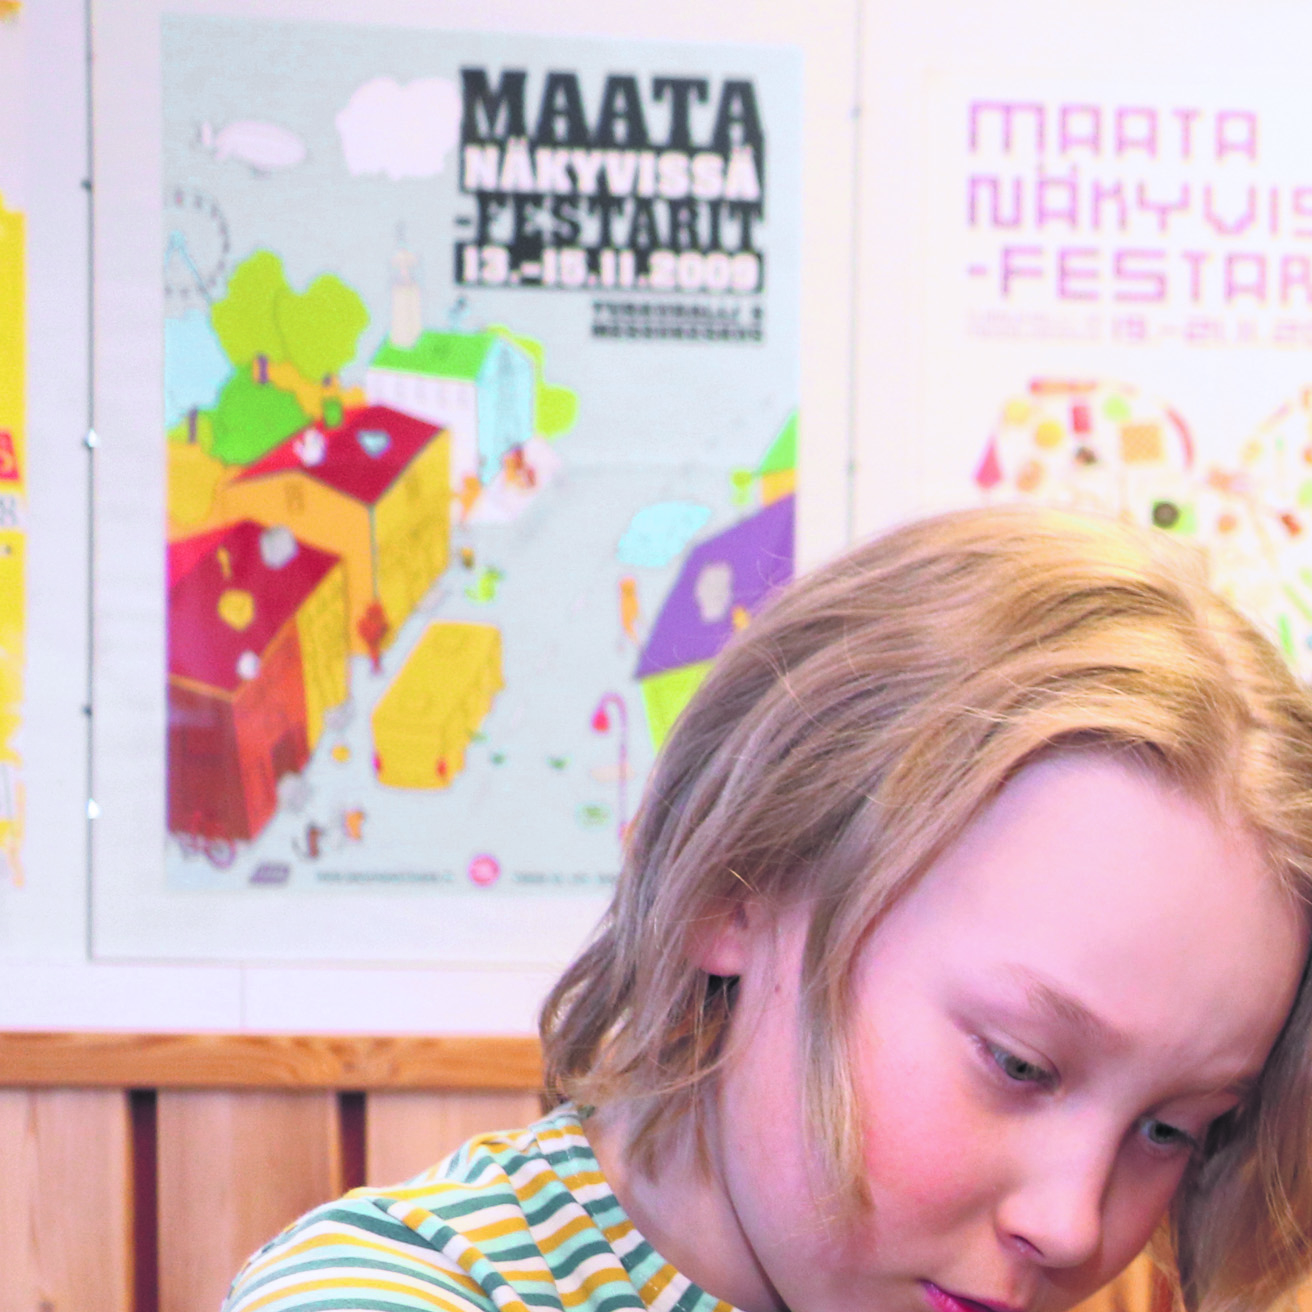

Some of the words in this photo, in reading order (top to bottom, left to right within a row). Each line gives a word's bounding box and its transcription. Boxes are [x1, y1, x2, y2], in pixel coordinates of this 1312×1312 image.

[461, 68, 763, 148] MAATA
[969, 101, 1258, 161] MAATA
[464, 136, 761, 199] NÄKYVISSÄ
[455, 197, 764, 250] -FESTARIT
